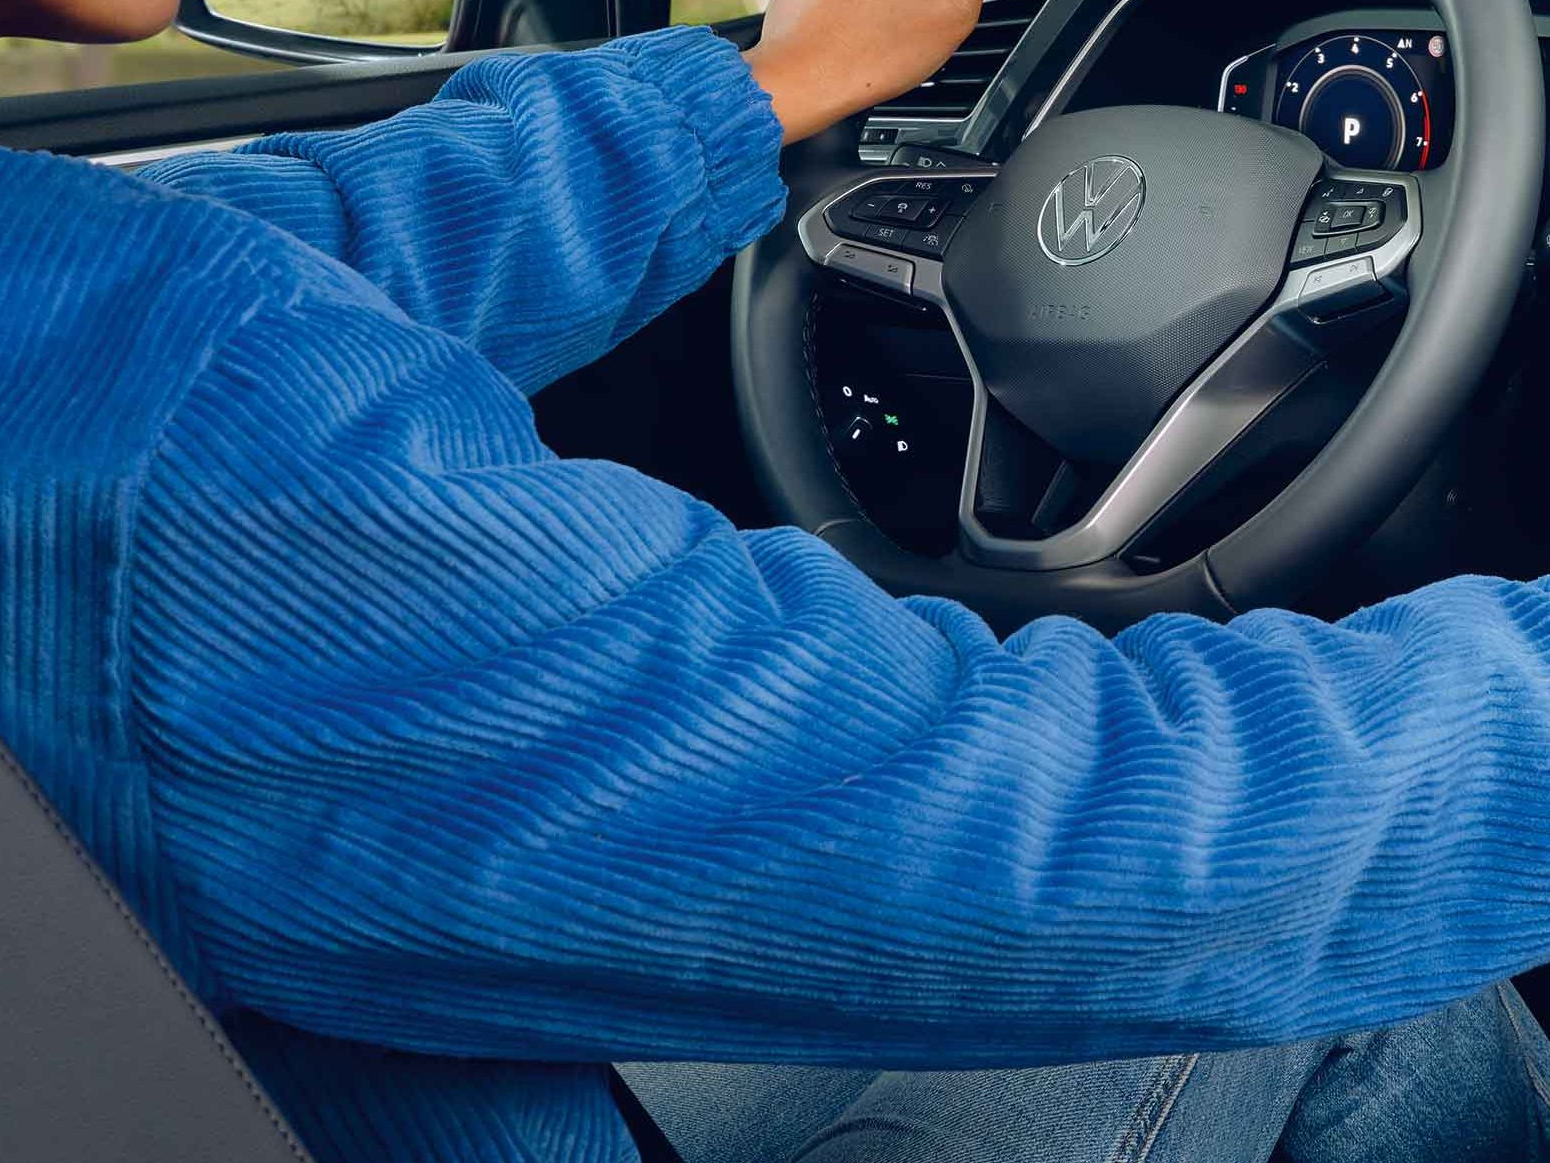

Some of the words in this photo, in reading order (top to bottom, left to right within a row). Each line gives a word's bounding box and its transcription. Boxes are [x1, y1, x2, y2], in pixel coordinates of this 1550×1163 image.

[1351, 43, 1359, 54] 4
[1317, 53, 1325, 64] 3
[1386, 58, 1393, 68] 5
[1291, 82, 1299, 93] 2
[1410, 92, 1418, 103] 6
[1343, 117, 1360, 145] P
[1416, 136, 1423, 147] 7
[915, 181, 932, 190] RES
[878, 228, 894, 238] SET
